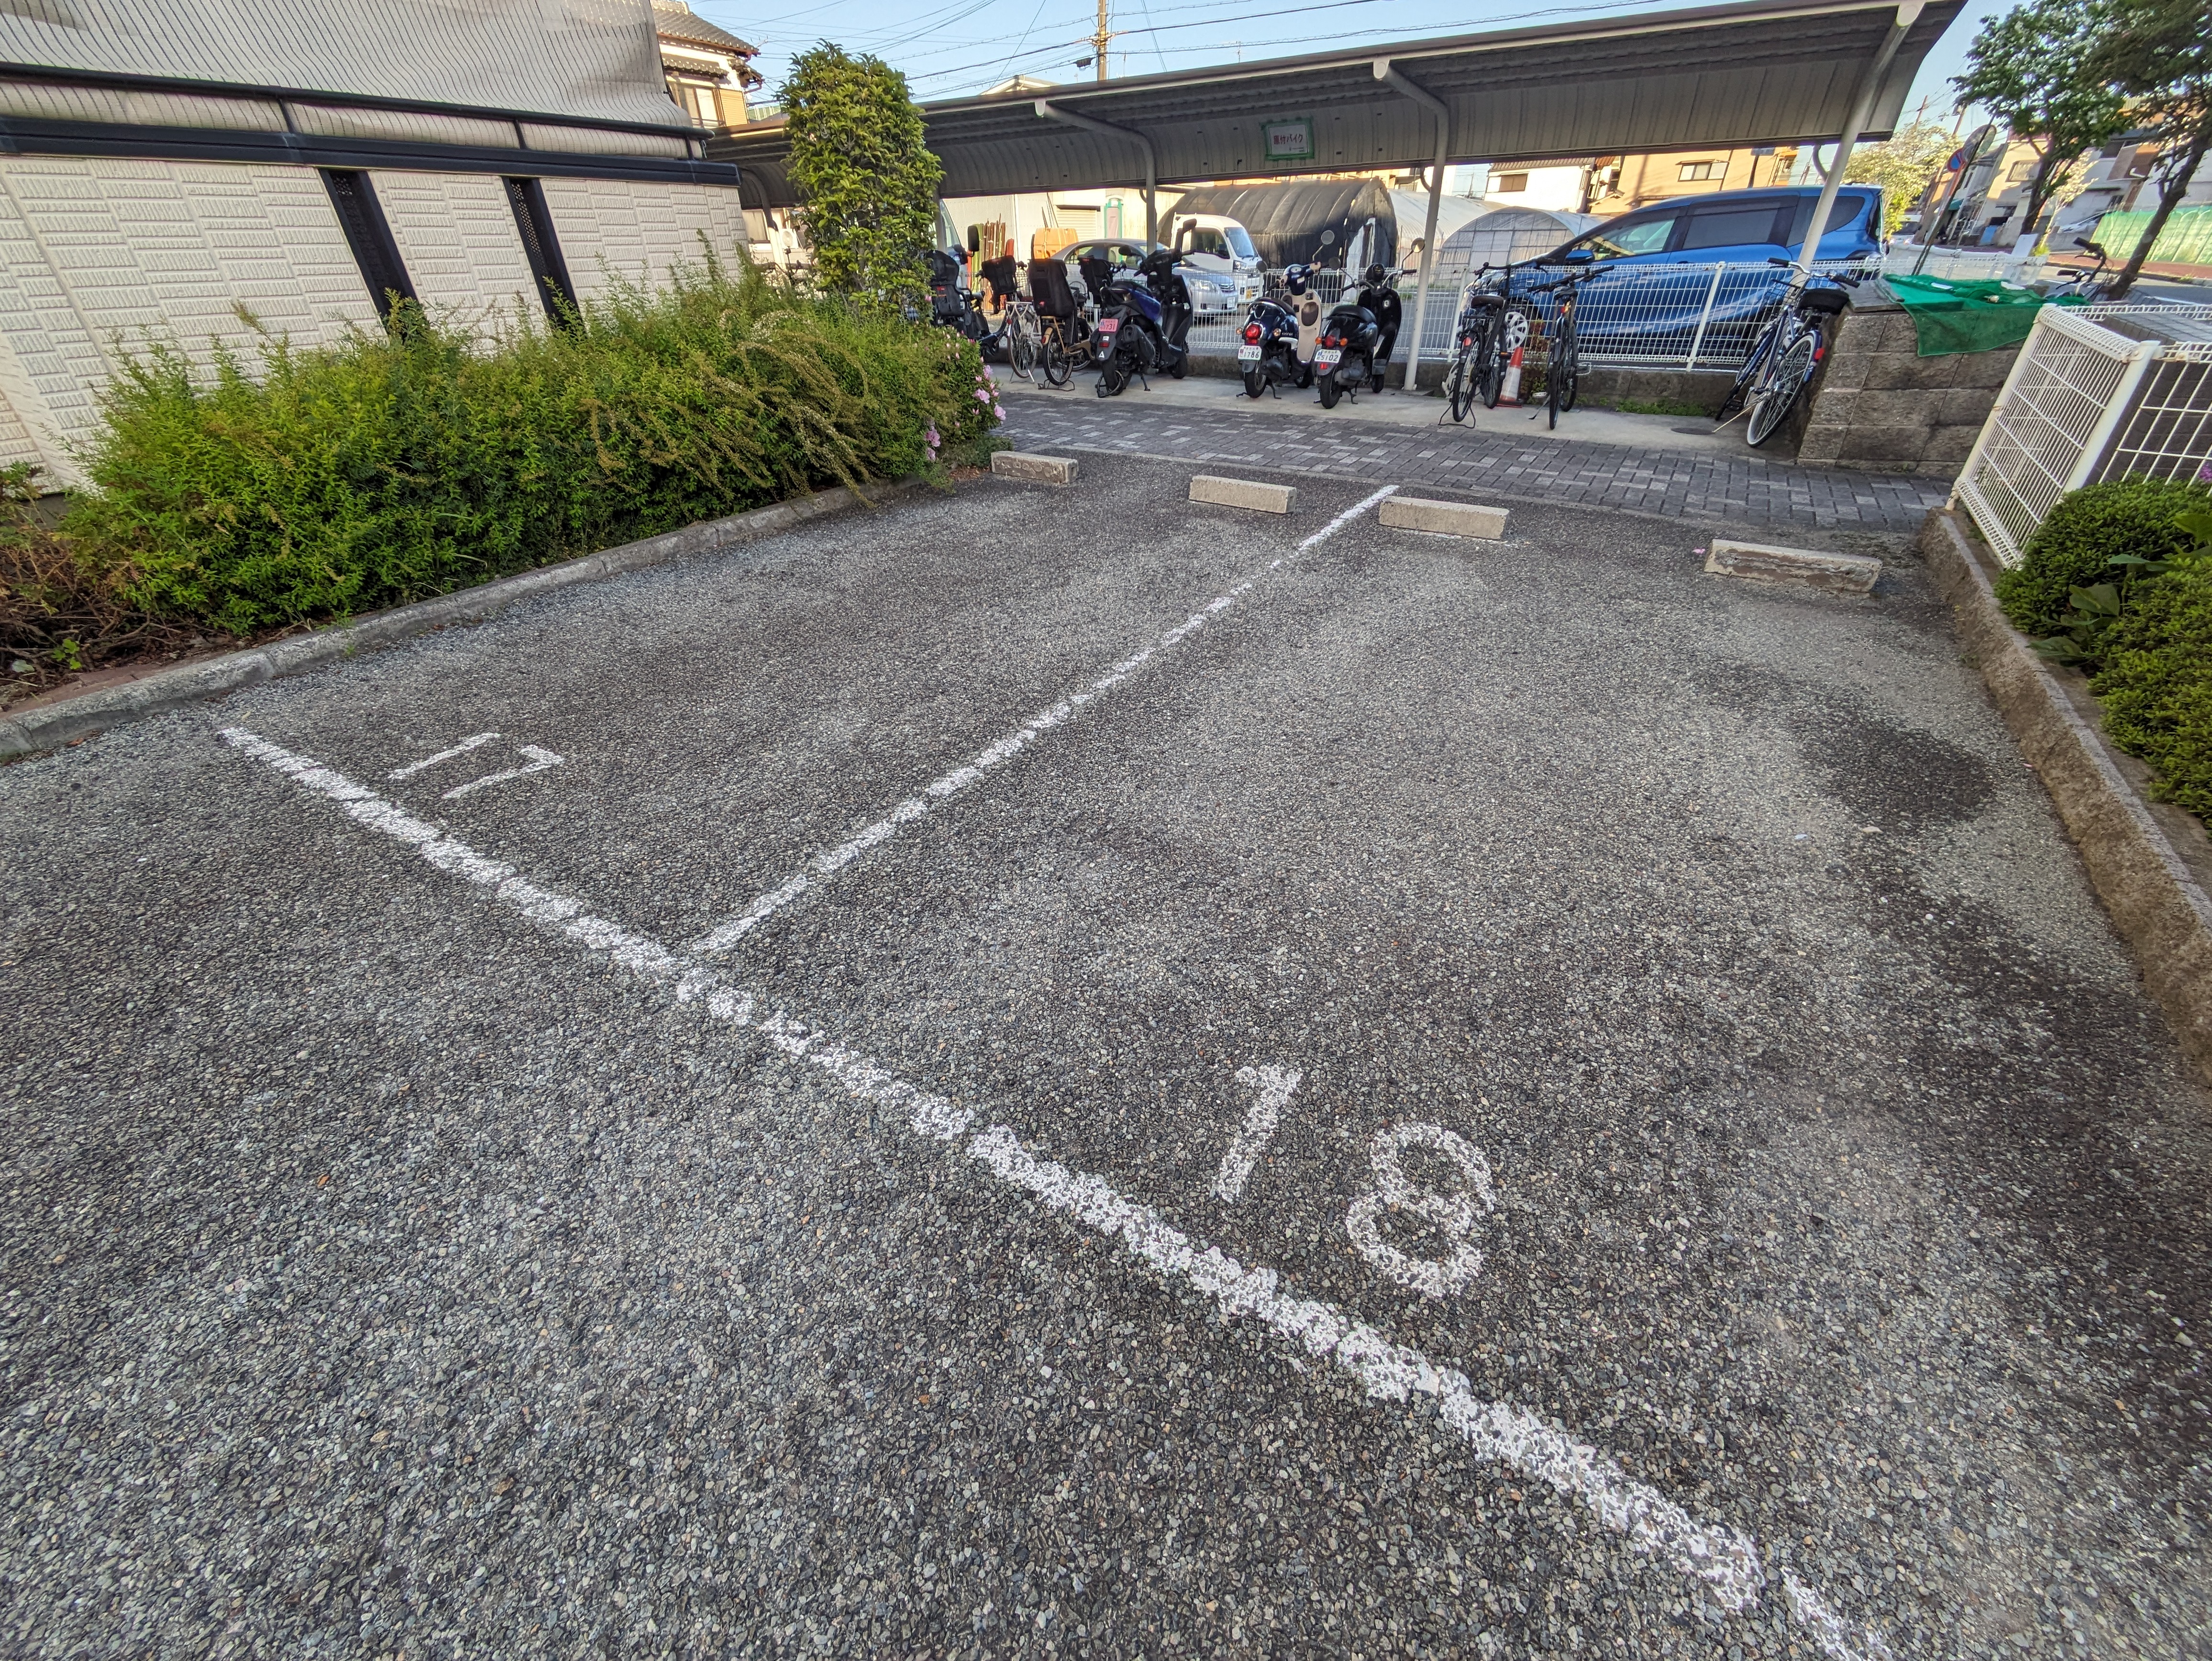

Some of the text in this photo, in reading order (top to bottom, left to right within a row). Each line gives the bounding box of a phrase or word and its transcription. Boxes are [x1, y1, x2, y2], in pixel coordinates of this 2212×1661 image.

[1273, 133, 1303, 144] 原付バイク
[389, 732, 565, 798] 17
[1210, 1064, 1498, 1297] 18
